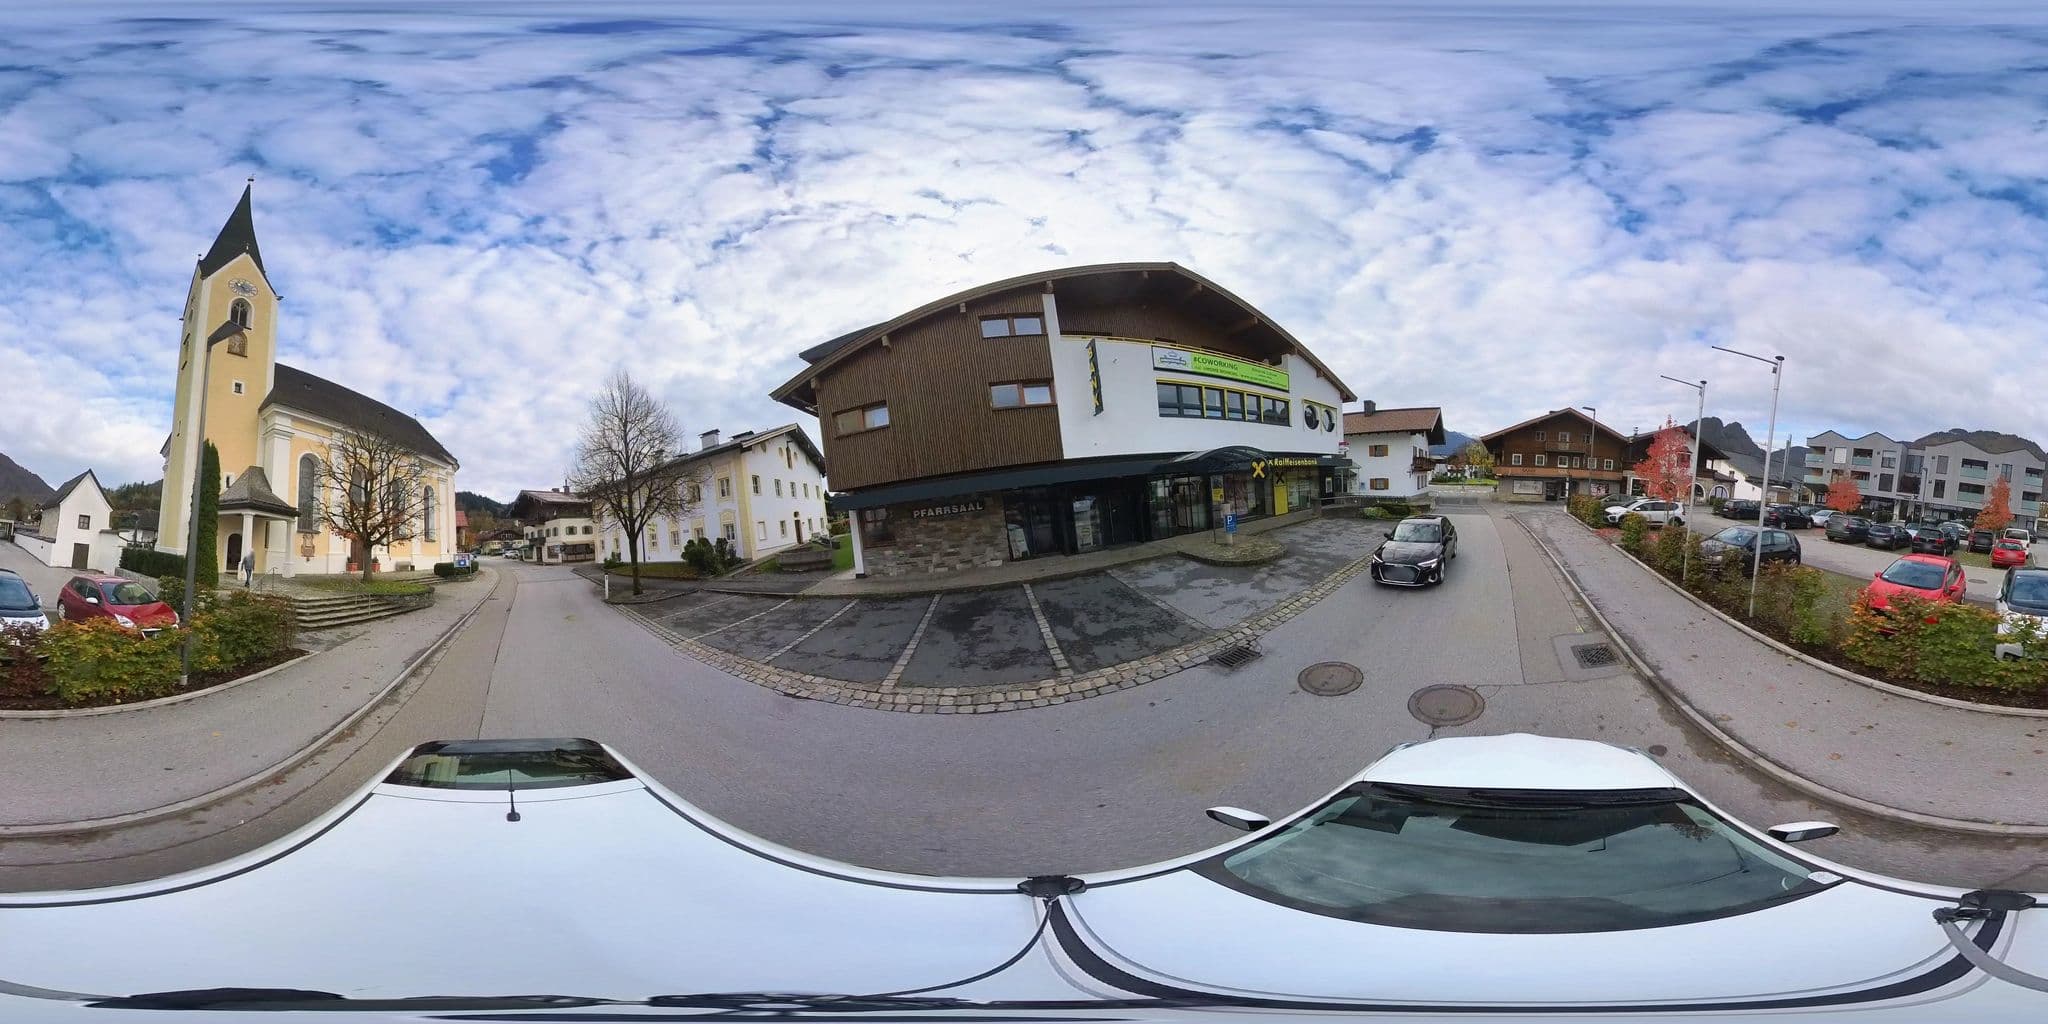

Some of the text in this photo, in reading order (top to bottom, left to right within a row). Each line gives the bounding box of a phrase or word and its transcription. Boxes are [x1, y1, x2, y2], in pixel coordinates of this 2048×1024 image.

[1087, 345, 1099, 407] BANK
[1274, 457, 1318, 467] Raiffeisenbank
[913, 501, 983, 518] PFARRSAAL
[1227, 515, 1233, 525] P
